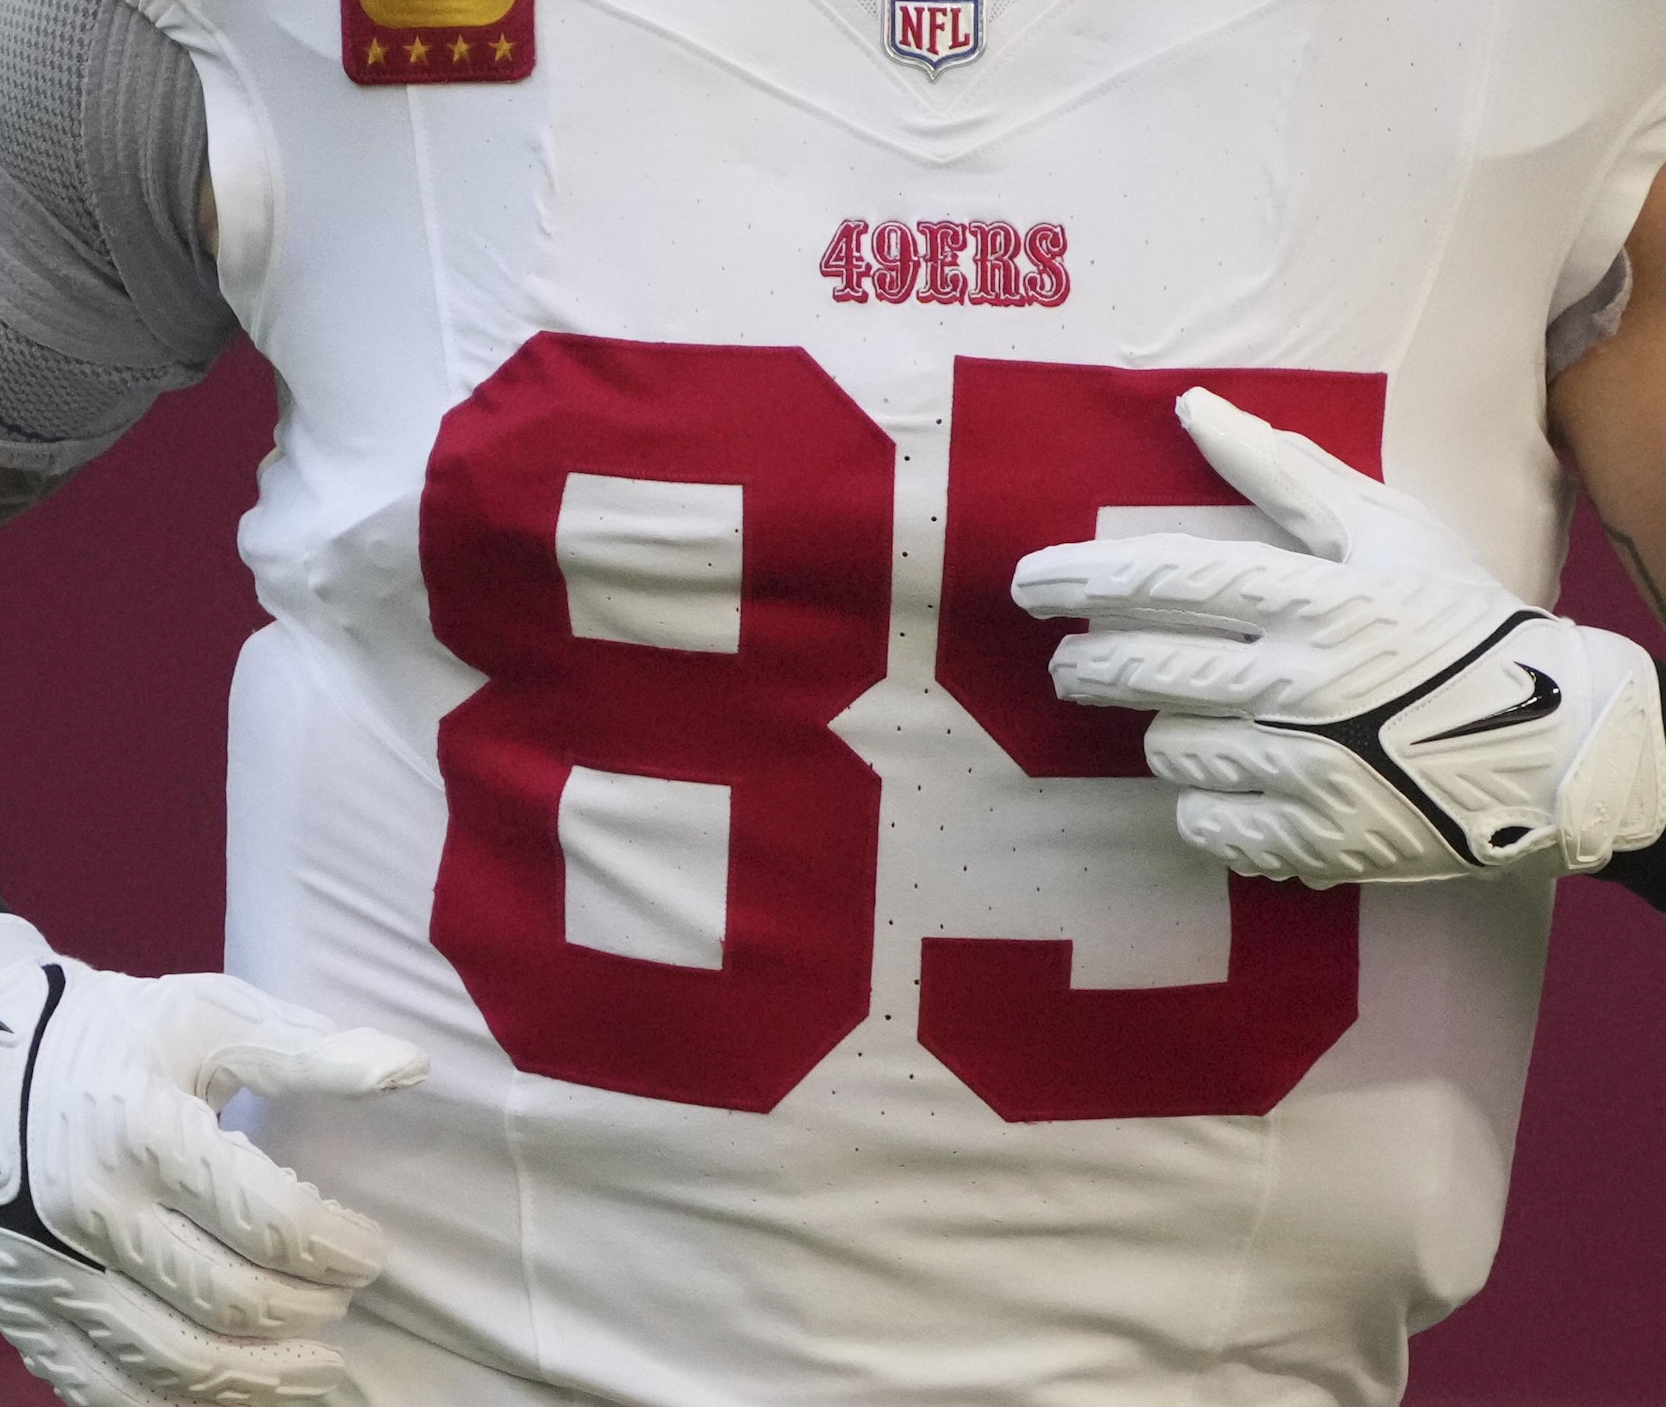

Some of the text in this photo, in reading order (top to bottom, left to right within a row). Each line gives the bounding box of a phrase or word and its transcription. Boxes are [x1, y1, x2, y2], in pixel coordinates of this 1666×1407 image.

[899, 5, 971, 56] NFL
[820, 219, 1071, 307] 49ERS
[419, 330, 1388, 1122] 85
